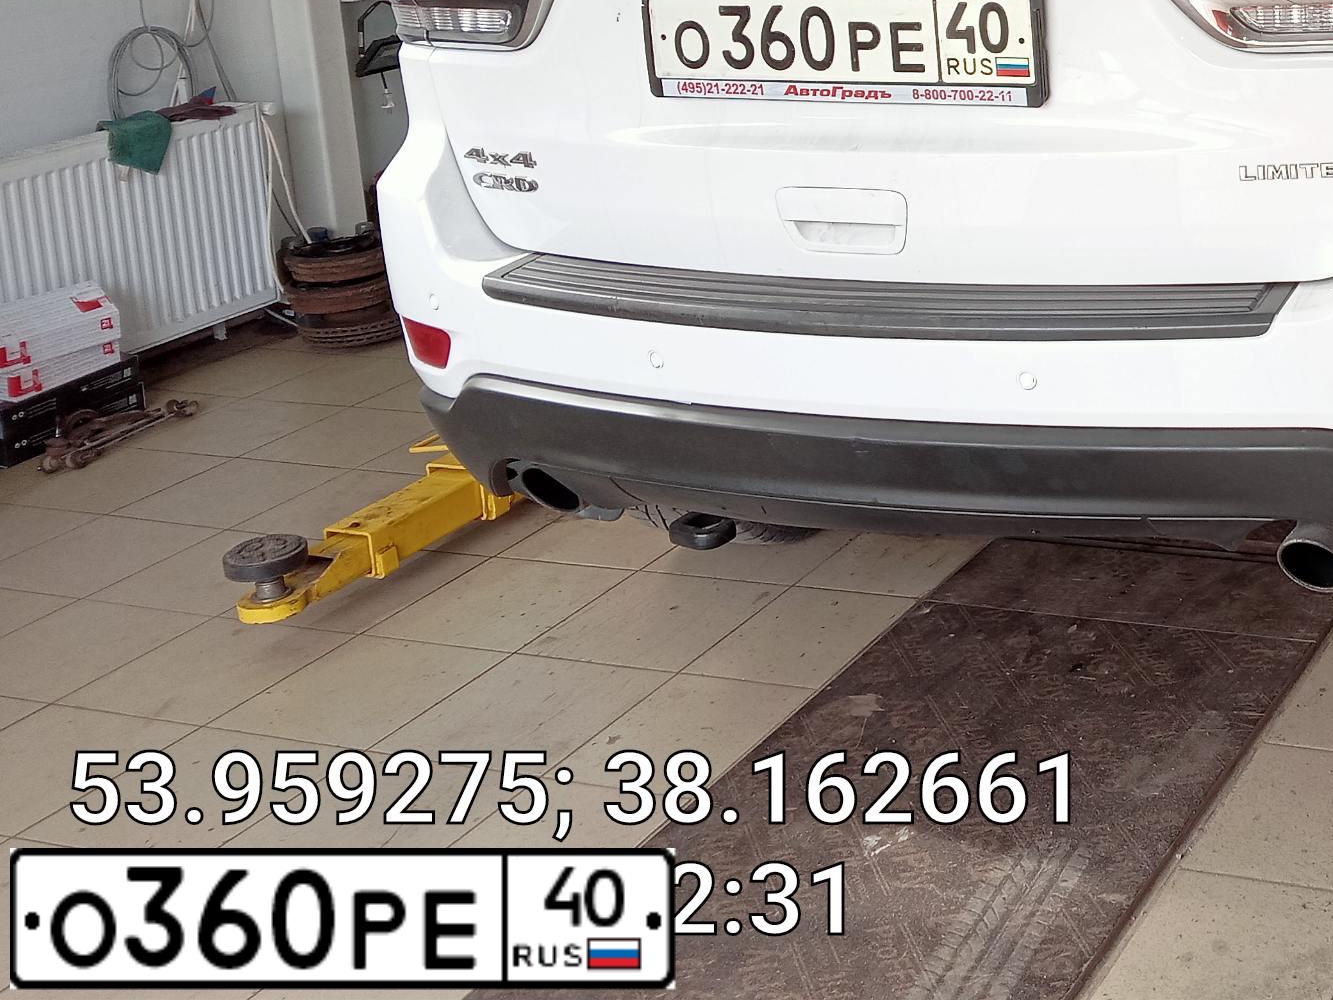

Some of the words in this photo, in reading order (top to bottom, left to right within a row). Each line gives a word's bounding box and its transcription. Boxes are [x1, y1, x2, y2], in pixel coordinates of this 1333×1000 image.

[674, 5, 926, 73] О360РЕ
[945, 1, 1009, 55] 40
[946, 57, 993, 76] RUS
[677, 81, 765, 98] (495)21-222-21
[783, 84, 892, 101] АвтоГрадъ
[911, 90, 1013, 104] 8-800-700-22-11
[464, 147, 537, 168] 4x4
[472, 171, 539, 193] CRD
